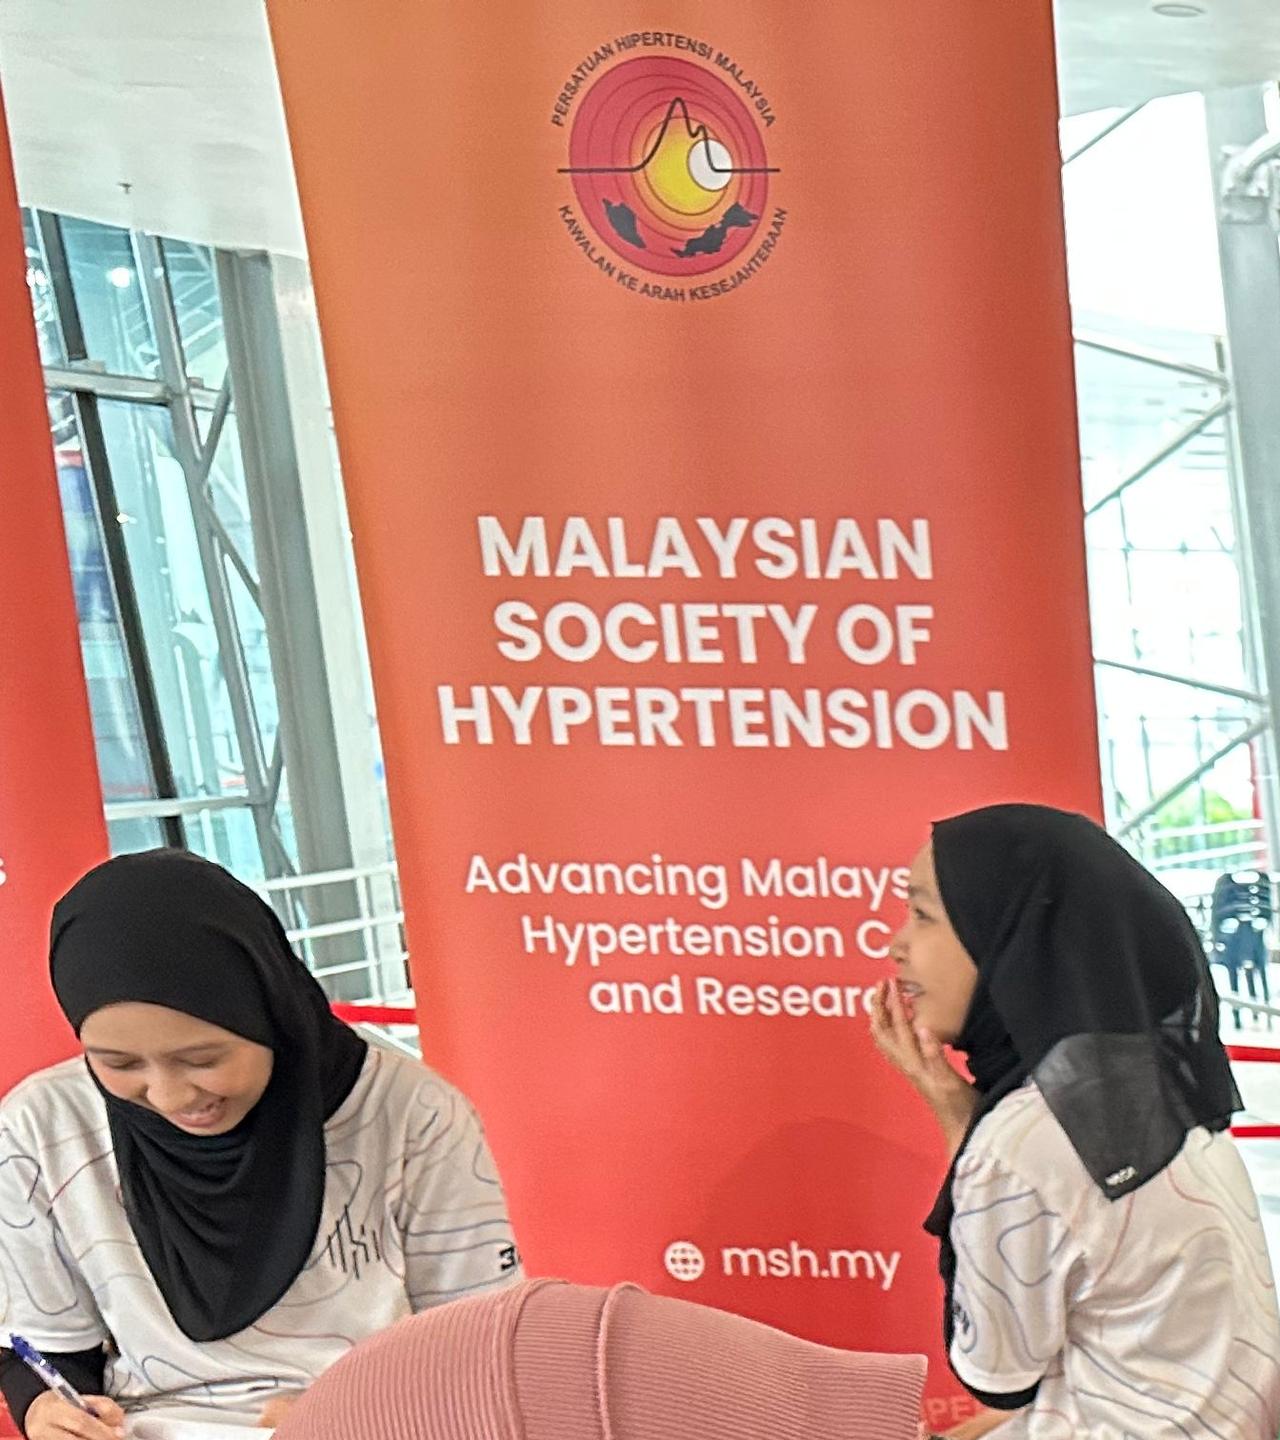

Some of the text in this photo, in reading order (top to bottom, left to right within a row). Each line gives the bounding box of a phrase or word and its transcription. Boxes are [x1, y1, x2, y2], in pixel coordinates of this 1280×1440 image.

[551, 32, 777, 128] PERSATUAN HIPERTENSI MALAYSIA
[558, 204, 788, 302] KAWALAN KE ARAH KESEJAHTERAAN
[477, 516, 933, 580] MALAYSIAN
[493, 601, 934, 665] SOCIETY OF
[436, 685, 1009, 751] HYPERTENSION
[465, 853, 911, 909] Advancing Malays
[522, 915, 844, 966] Hypertension
[588, 975, 877, 1018] and Researc
[722, 1240, 902, 1291] msh.my
